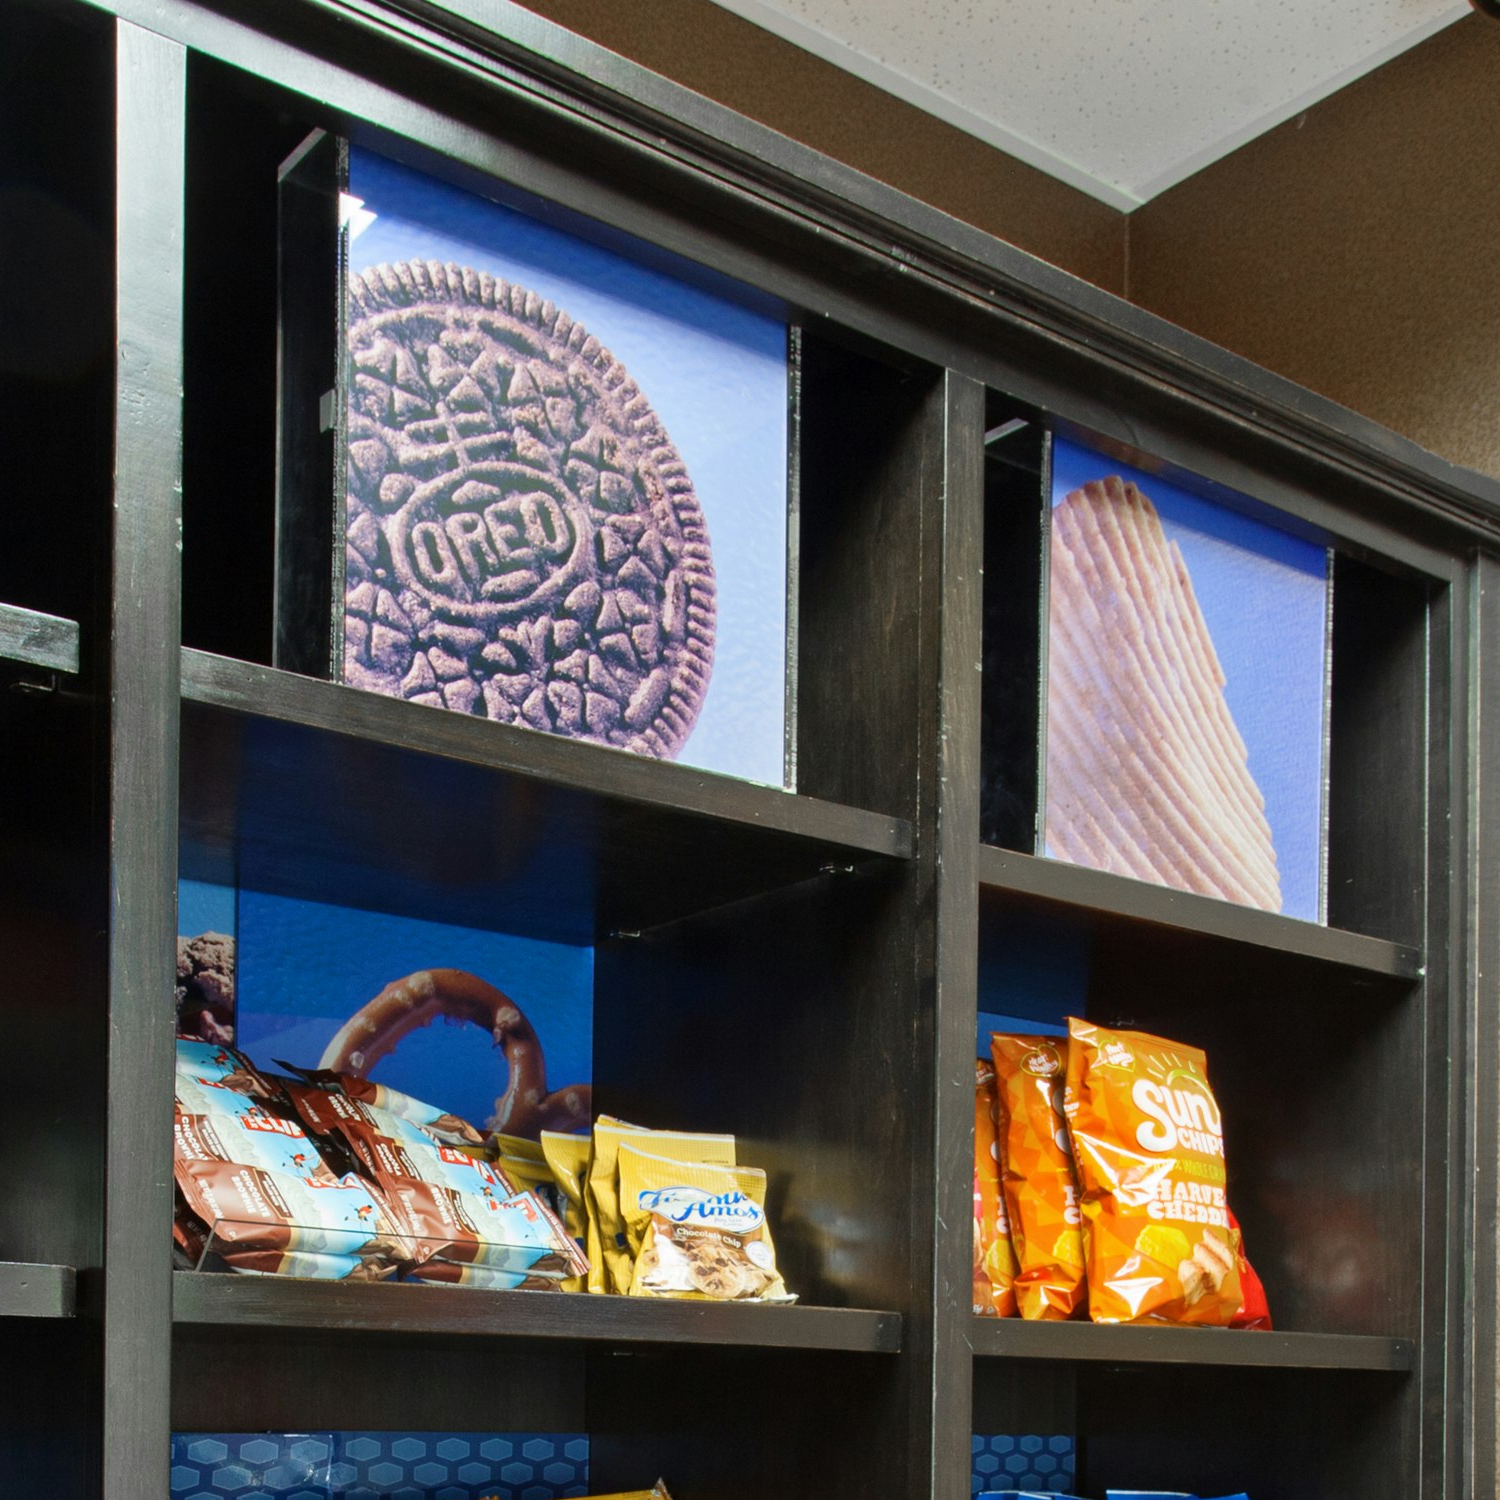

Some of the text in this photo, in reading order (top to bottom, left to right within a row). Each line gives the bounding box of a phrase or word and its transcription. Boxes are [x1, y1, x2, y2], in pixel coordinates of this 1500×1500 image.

[410, 489, 573, 587] OREO
[1132, 1078, 1223, 1153] Sun
[231, 1175, 257, 1215] BROWNIE
[238, 1169, 272, 1219] CHOCOLATE
[1155, 1178, 1226, 1209] HARVE
[671, 1201, 760, 1222] Amos
[1146, 1199, 1229, 1228] CHEDD
[676, 1227, 742, 1249] Chocolate Chip
